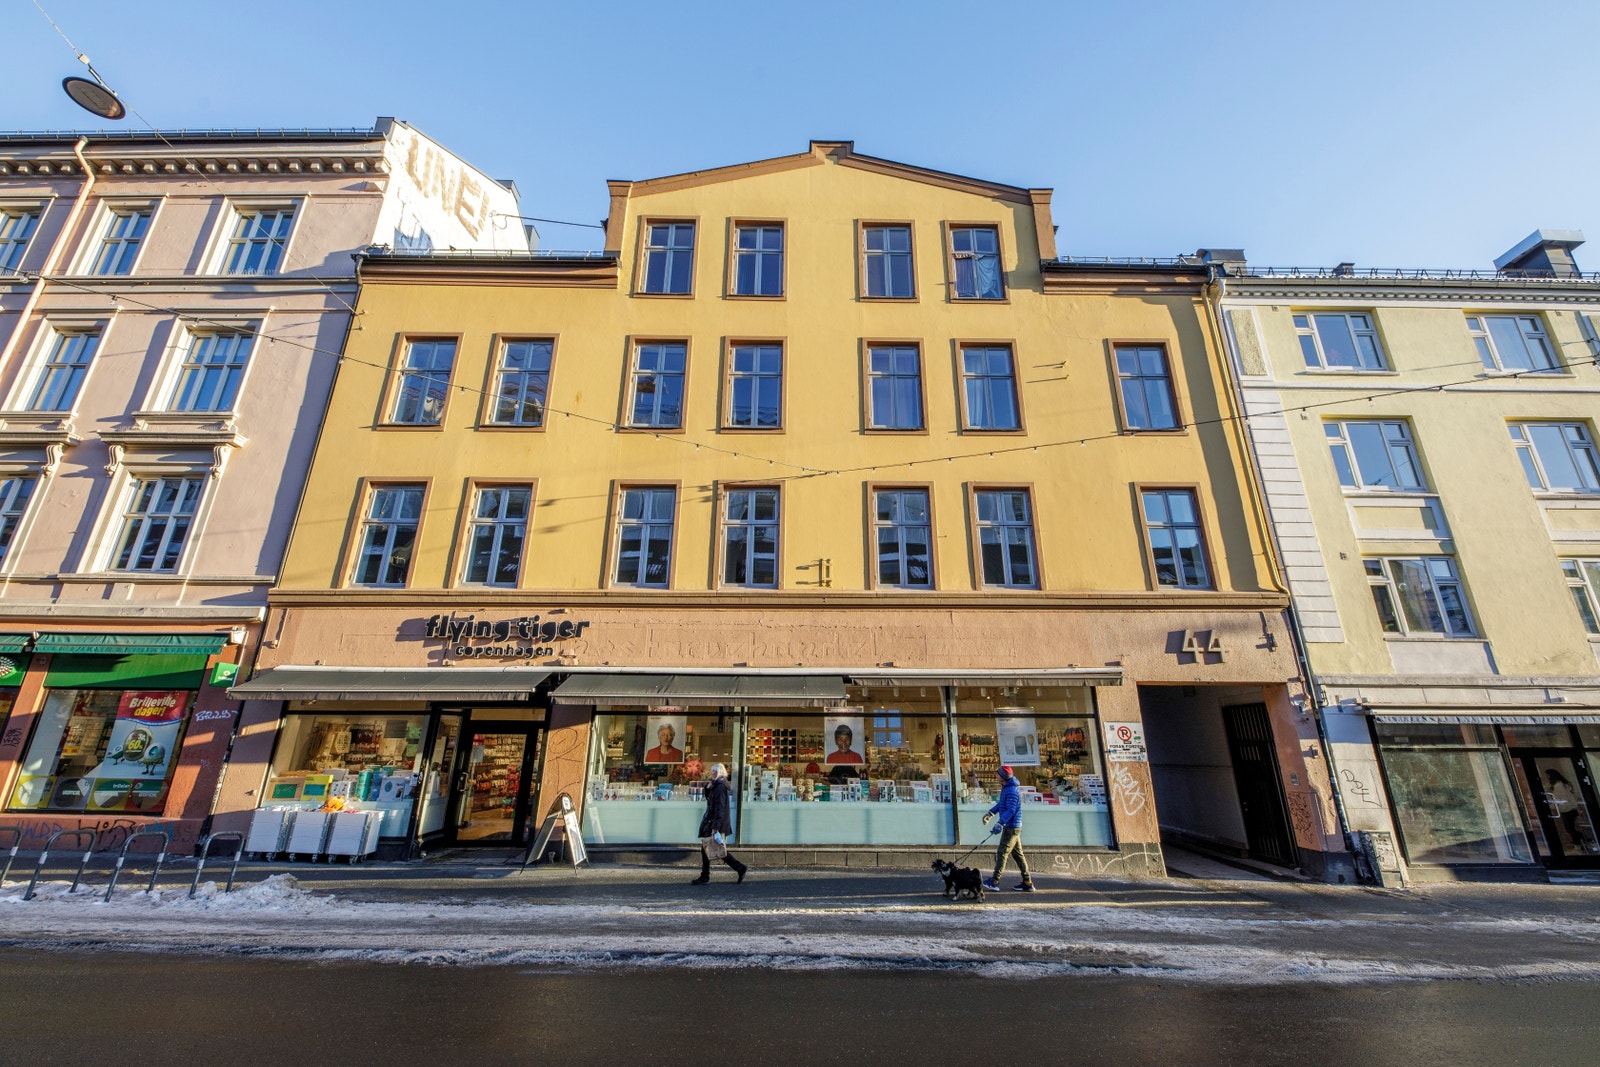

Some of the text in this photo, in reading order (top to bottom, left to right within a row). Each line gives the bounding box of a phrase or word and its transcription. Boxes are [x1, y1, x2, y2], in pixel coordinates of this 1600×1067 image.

[425, 614, 591, 643] flying tiger
[455, 644, 555, 659] copenhagen
[1181, 629, 1230, 664] 44
[129, 695, 177, 708] Brilleville
[134, 706, 166, 717] dager!
